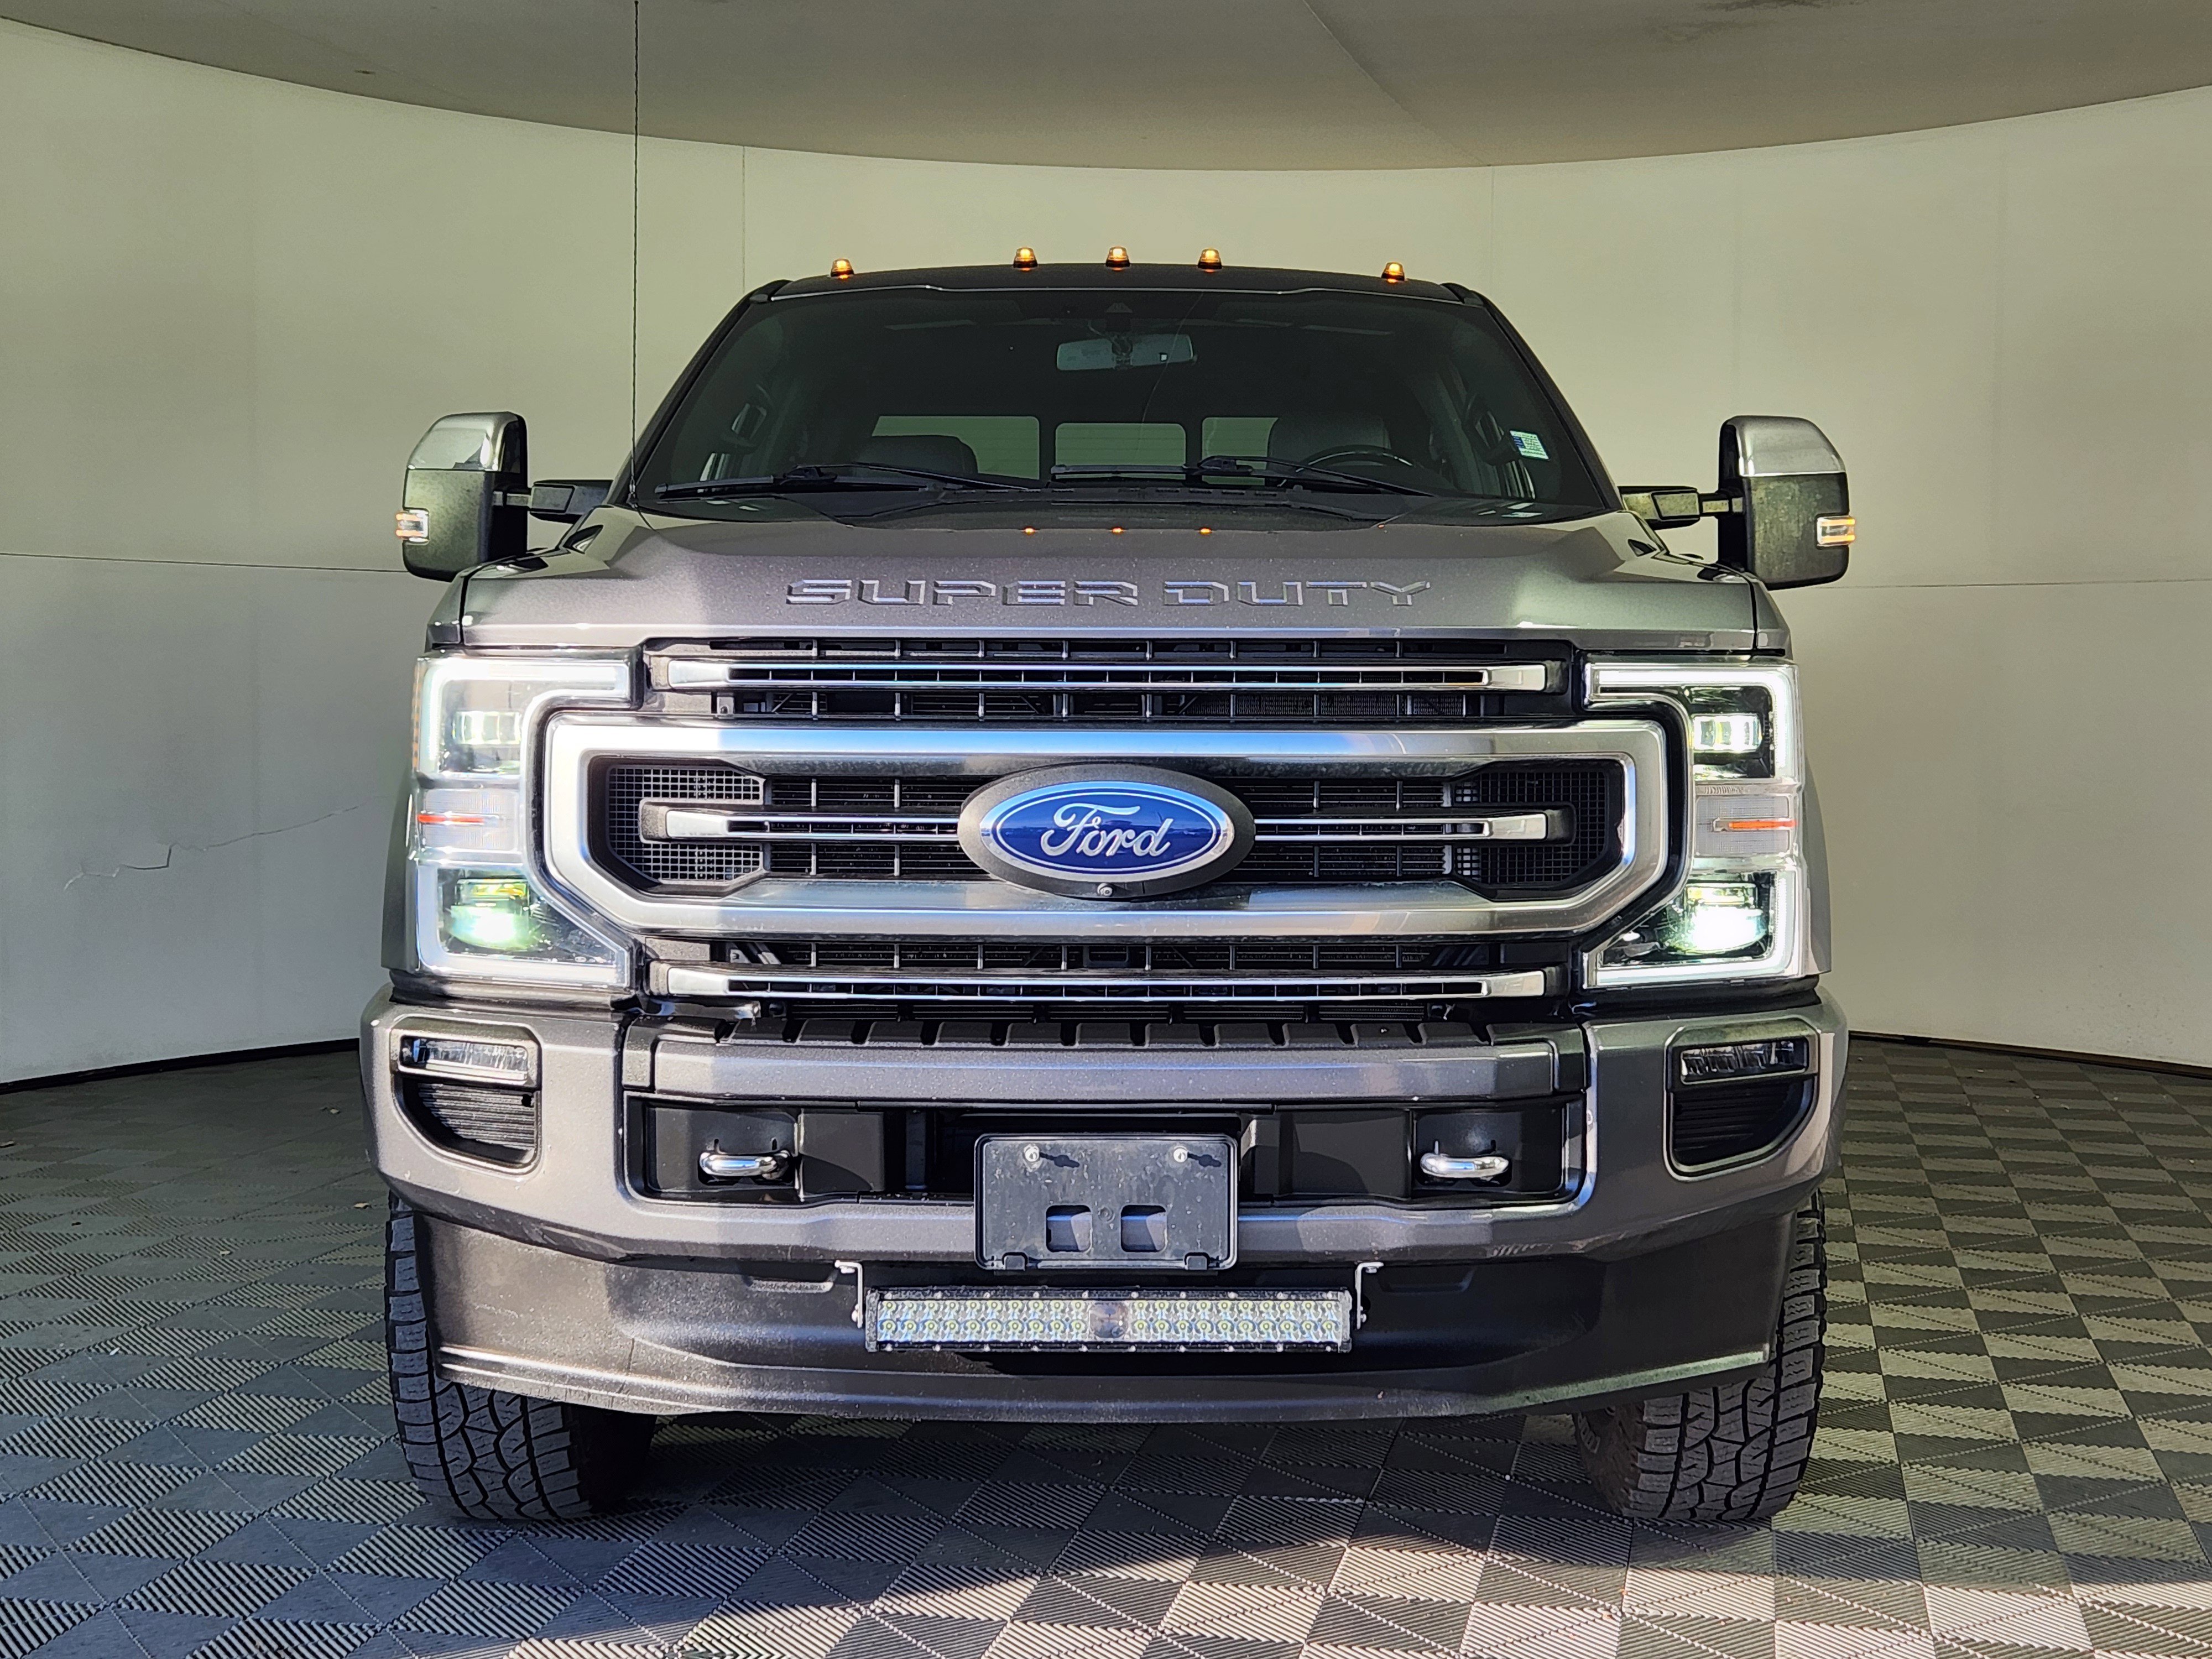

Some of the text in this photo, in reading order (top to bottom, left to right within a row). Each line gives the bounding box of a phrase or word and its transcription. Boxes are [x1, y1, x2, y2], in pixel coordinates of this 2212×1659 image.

[786, 580, 1431, 607] SUPER DUTY
[1040, 802, 1174, 857] Ford
